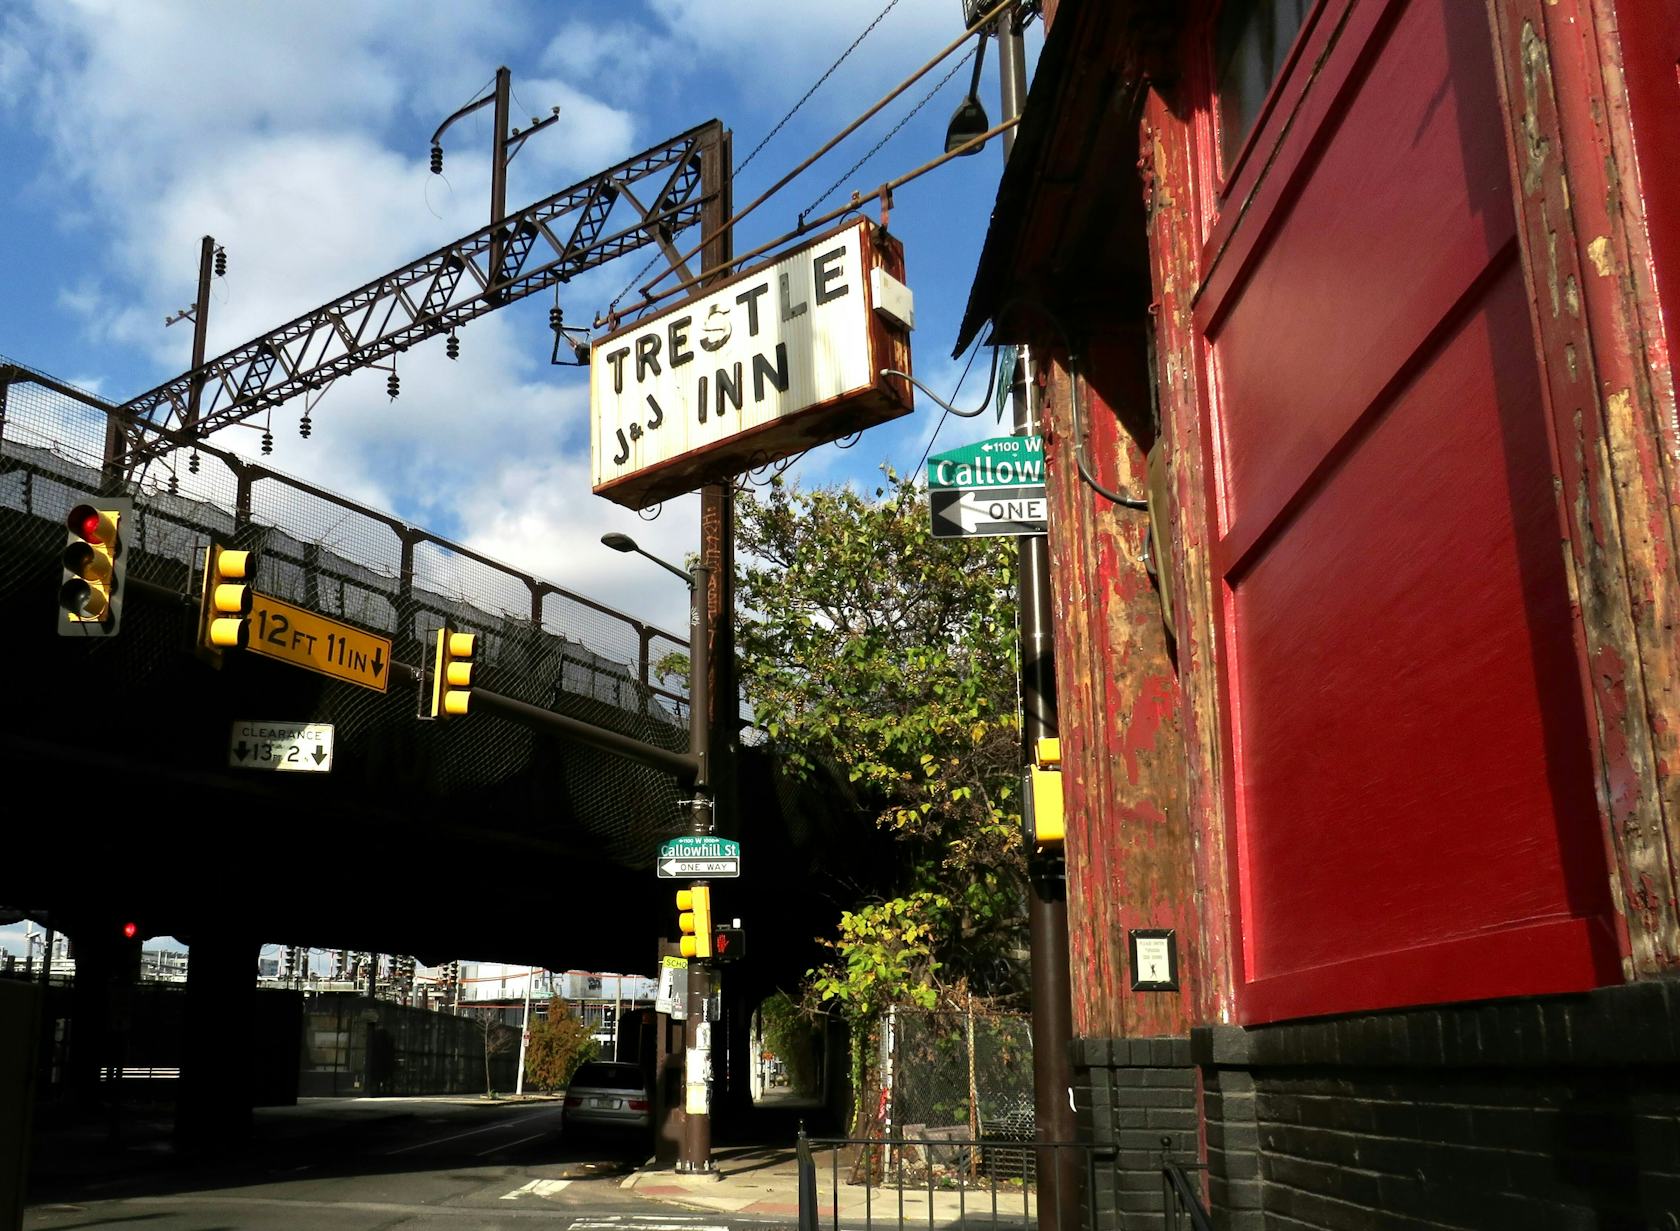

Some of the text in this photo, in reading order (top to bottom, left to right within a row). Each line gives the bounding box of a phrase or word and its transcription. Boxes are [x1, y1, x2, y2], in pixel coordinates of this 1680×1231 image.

[607, 245, 849, 394] TRESTLE
[613, 342, 789, 465] J&J INN
[993, 438, 1042, 453] 1100 W
[989, 501, 1041, 520] ONE
[241, 727, 323, 741] CLEARANCE
[661, 843, 737, 857] Callowhill St
[680, 863, 727, 871] ONE WAY
